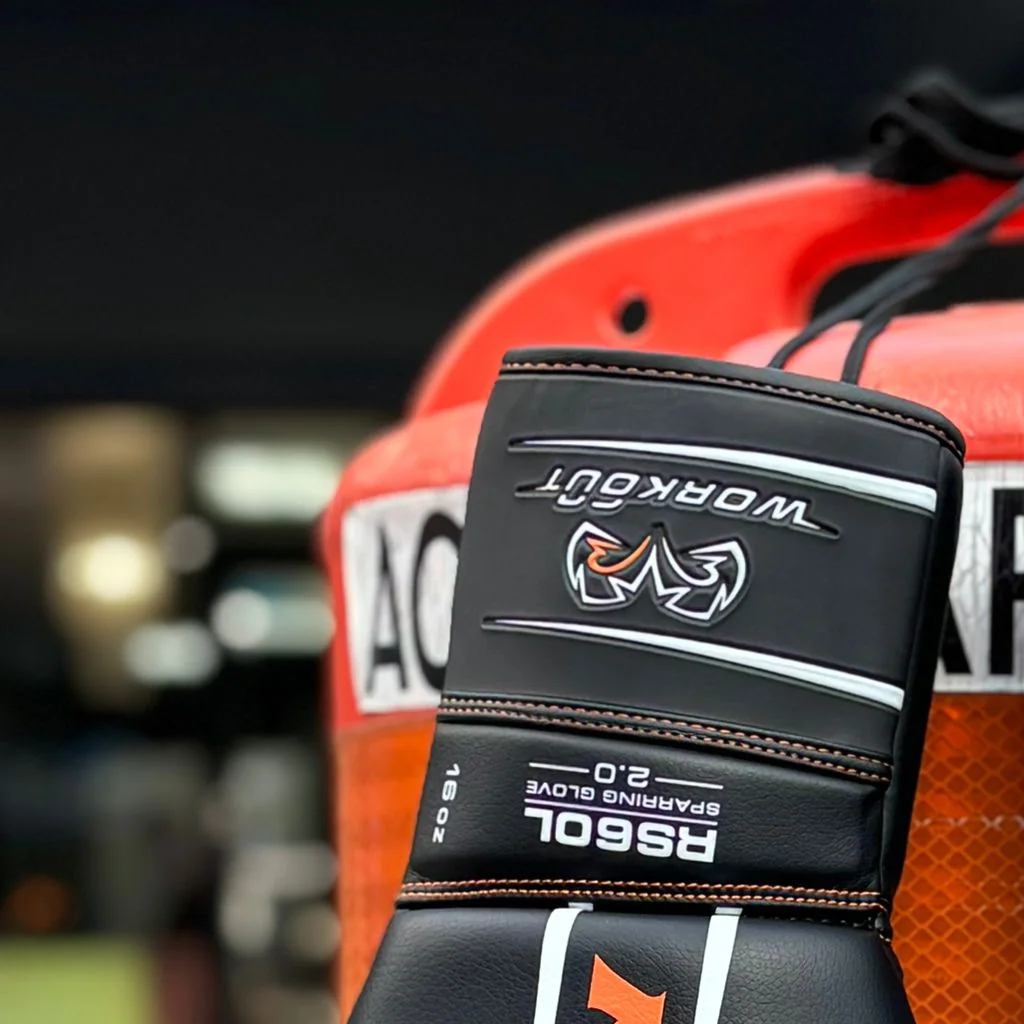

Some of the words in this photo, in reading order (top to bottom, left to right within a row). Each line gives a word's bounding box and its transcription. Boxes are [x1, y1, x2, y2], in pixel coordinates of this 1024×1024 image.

[534, 467, 821, 531] WORKOUT
[441, 763, 461, 802] 16
[525, 780, 595, 801] GLOVE
[593, 762, 651, 788] 2.0
[602, 789, 721, 816] SPARRING
[523, 806, 719, 863] RS60L
